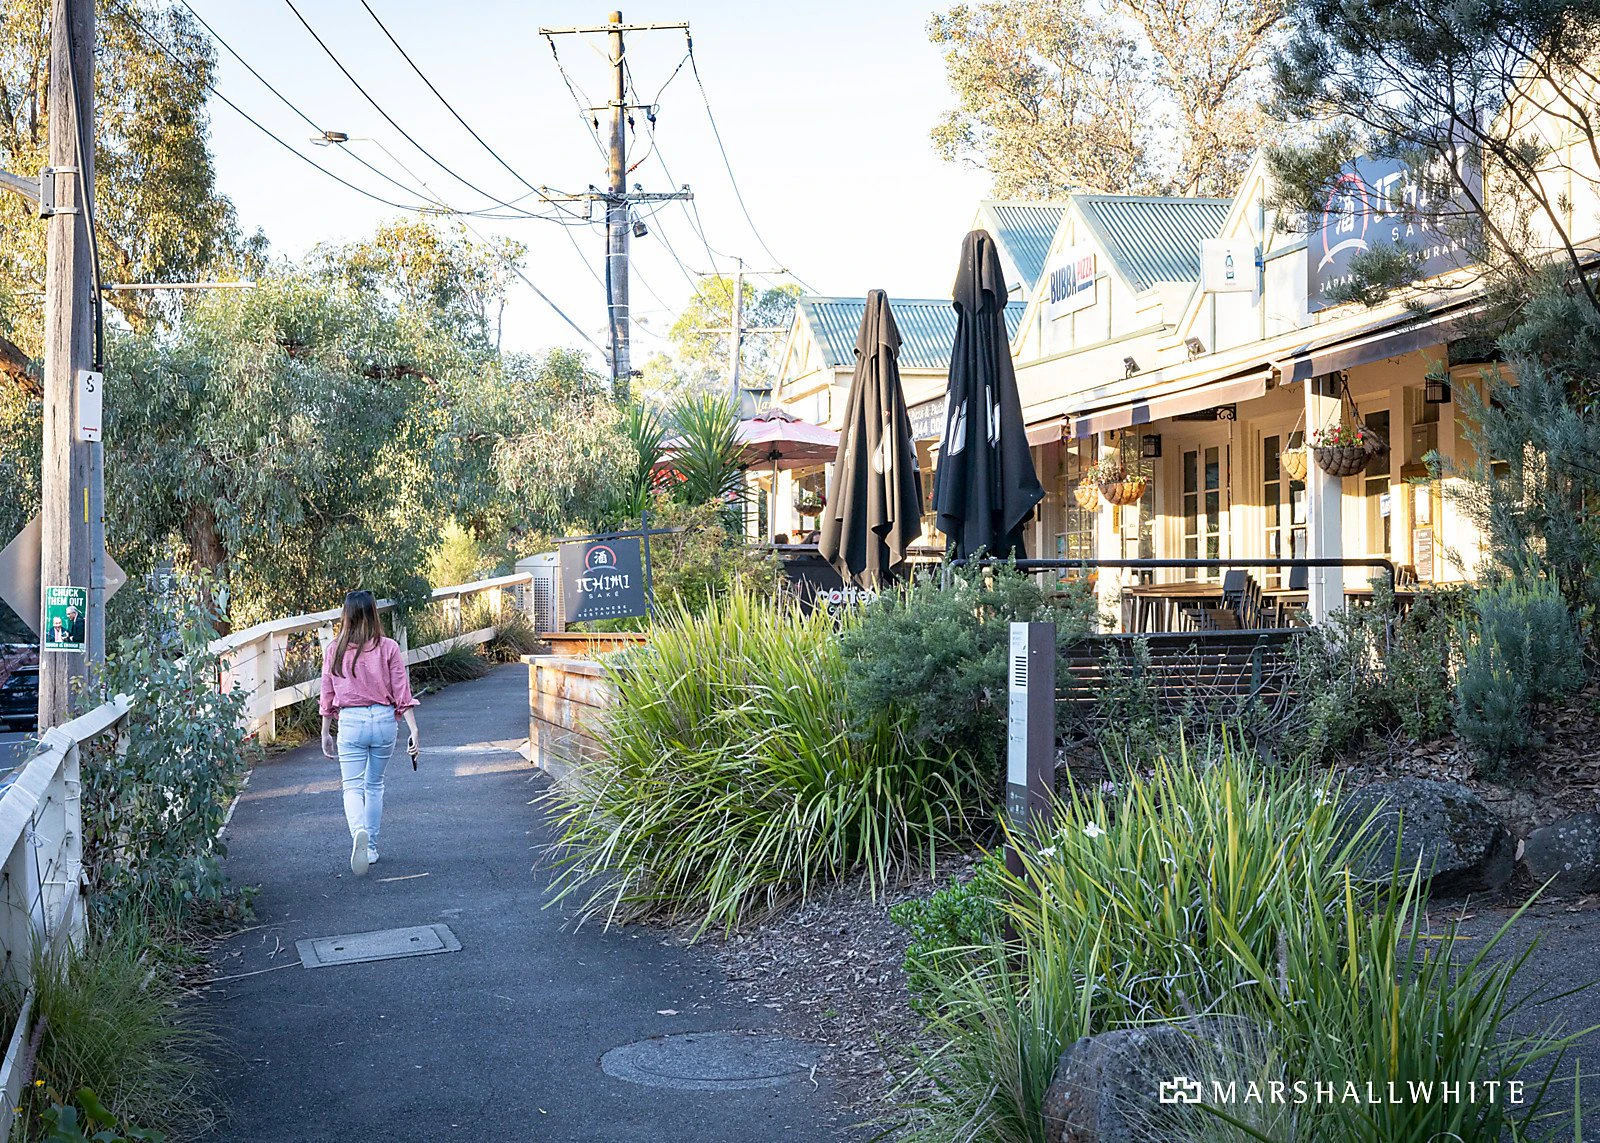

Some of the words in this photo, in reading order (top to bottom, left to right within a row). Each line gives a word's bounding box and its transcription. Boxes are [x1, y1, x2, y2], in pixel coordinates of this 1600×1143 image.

[1051, 262, 1077, 304] BUBBA
[594, 550, 607, 564] 酒
[575, 574, 630, 593] ICHIMI
[52, 588, 79, 598] CHUCK
[48, 597, 67, 606] THEM
[69, 598, 84, 606] OUT
[583, 604, 627, 612] JAPANESE
[578, 609, 632, 618] RESTAURANT
